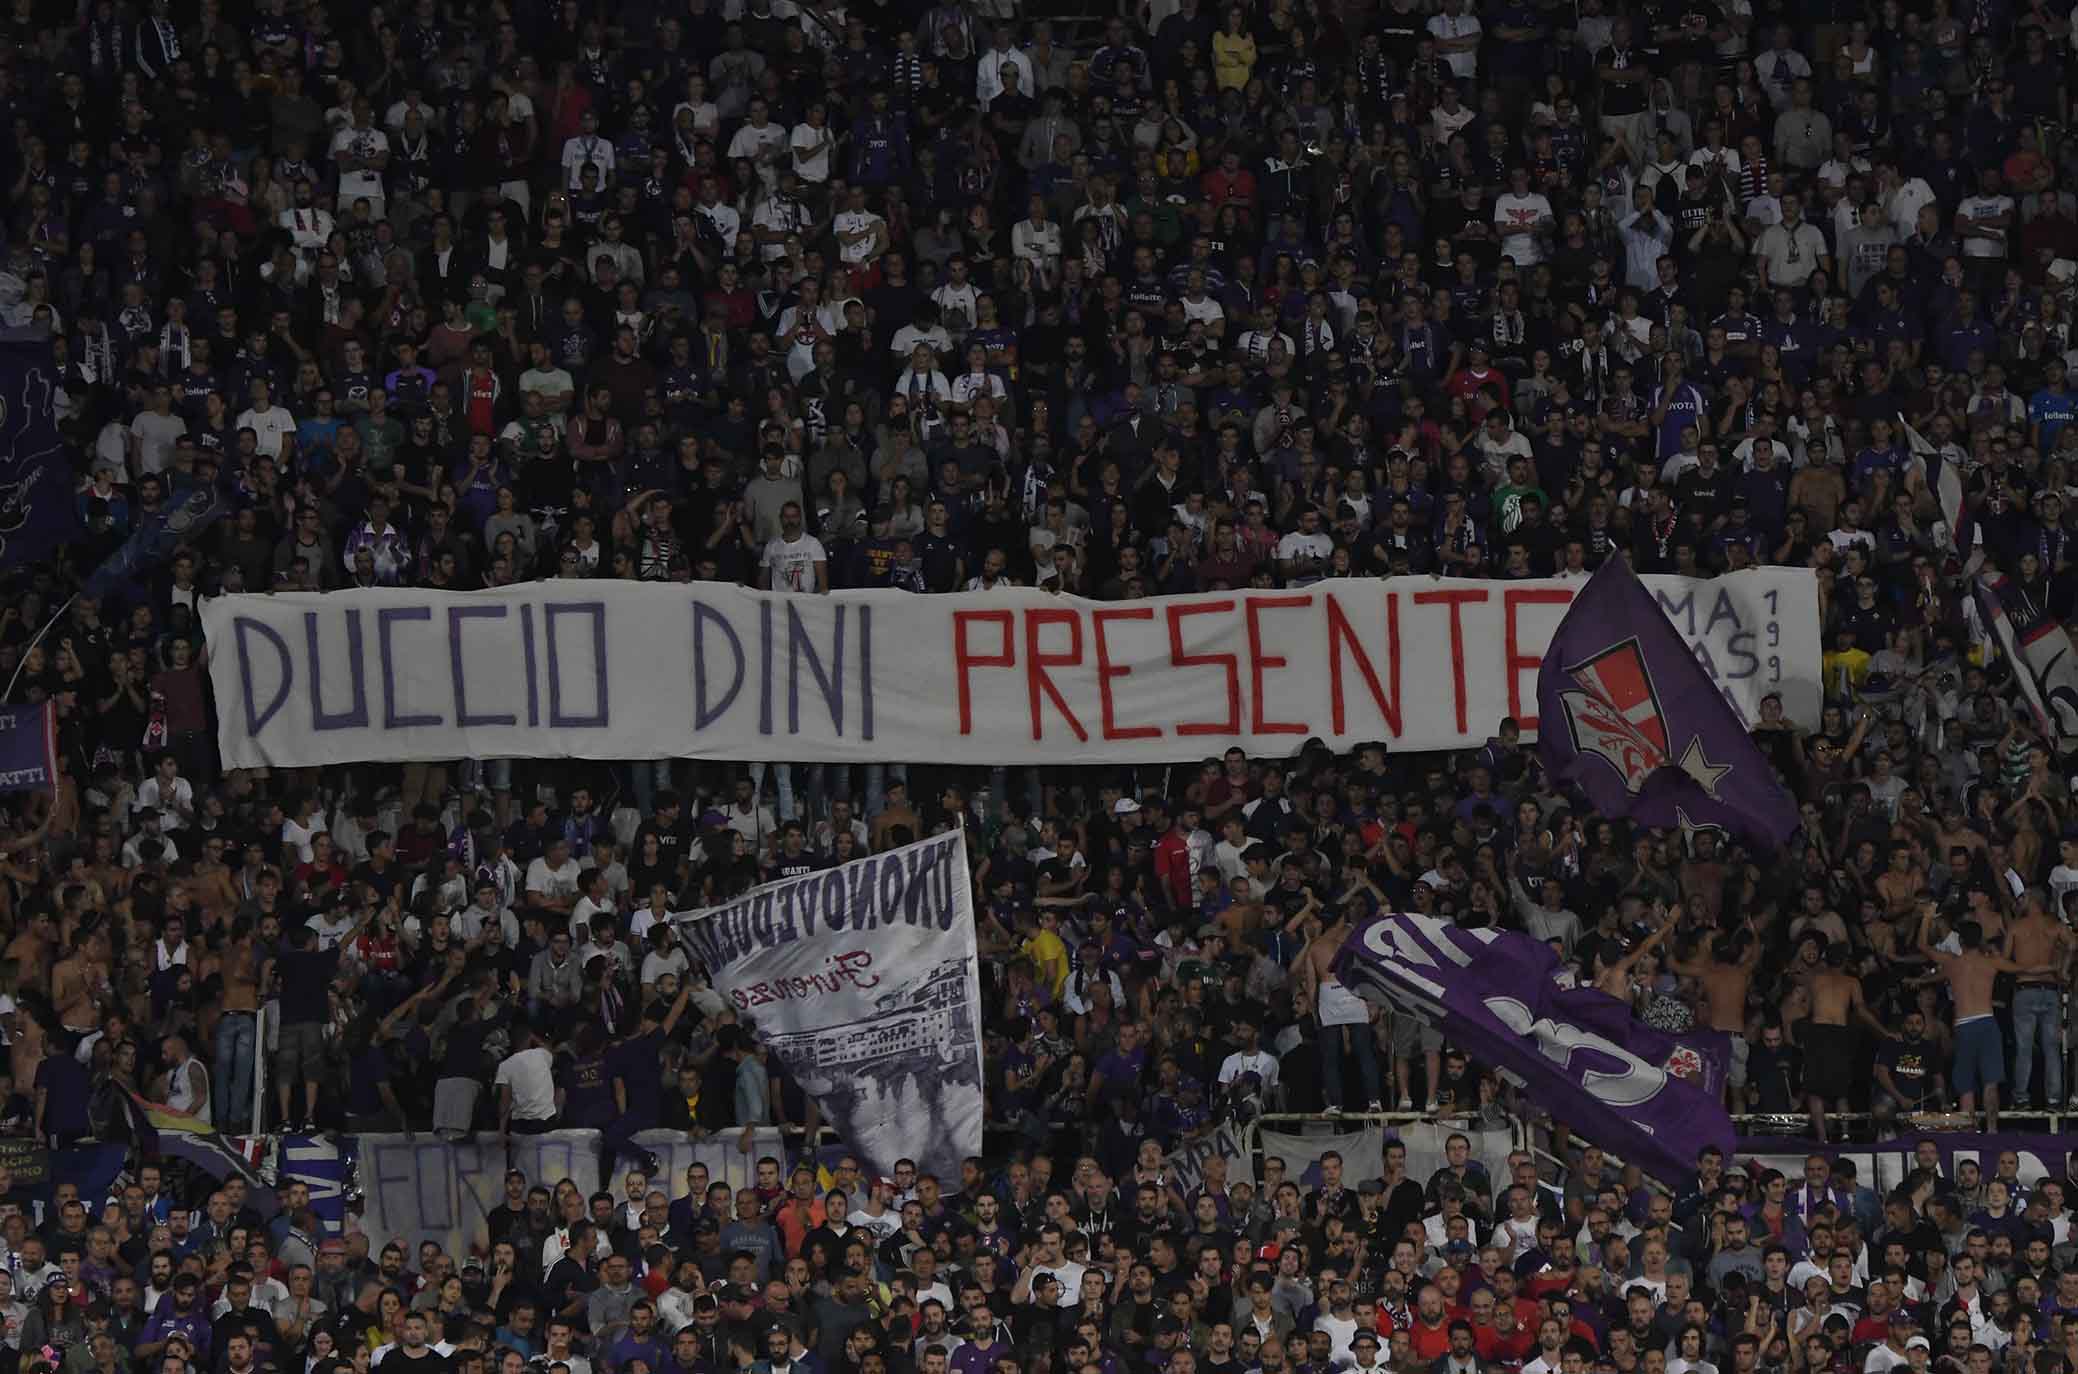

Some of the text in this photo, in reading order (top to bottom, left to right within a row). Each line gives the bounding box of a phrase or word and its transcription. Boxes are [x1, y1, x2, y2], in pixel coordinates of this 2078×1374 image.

[234, 590, 1574, 741] DUCCIO DINI PRESENTE
